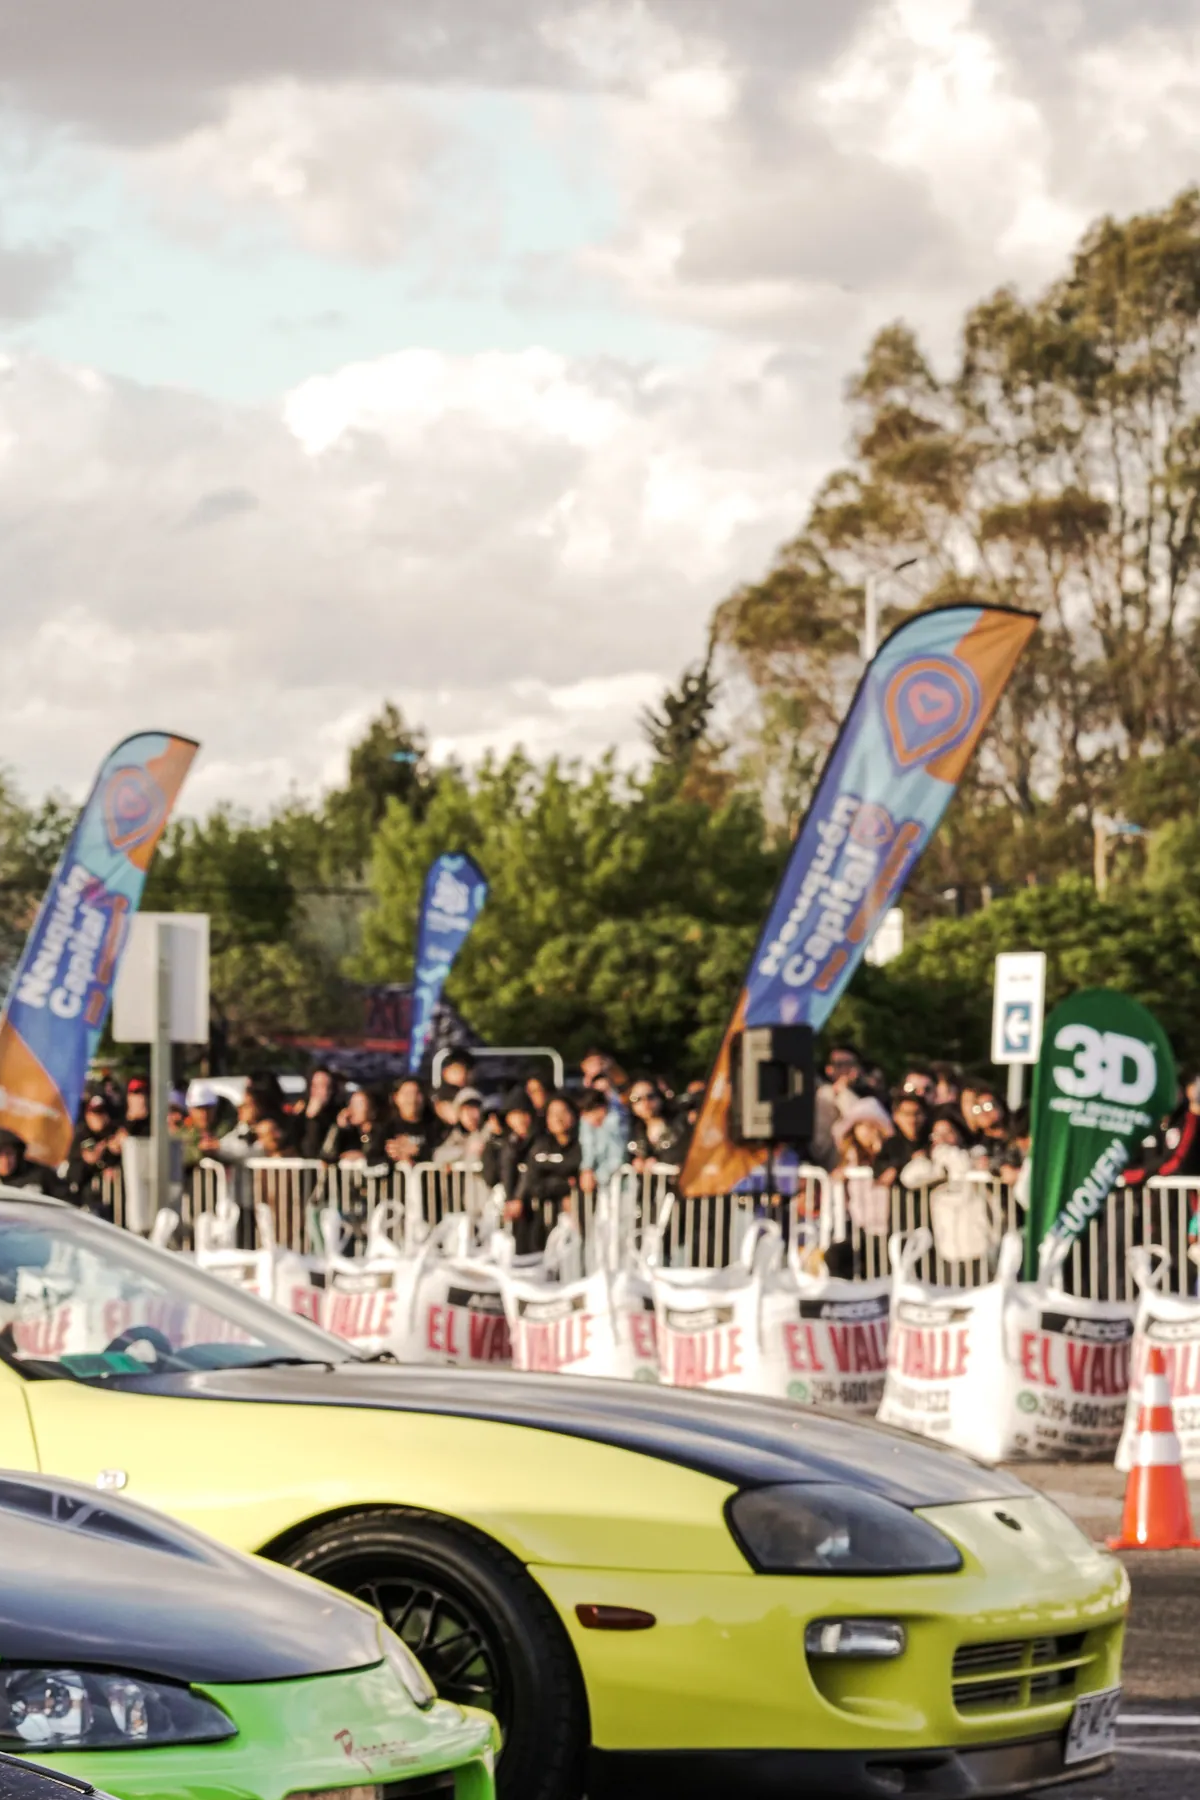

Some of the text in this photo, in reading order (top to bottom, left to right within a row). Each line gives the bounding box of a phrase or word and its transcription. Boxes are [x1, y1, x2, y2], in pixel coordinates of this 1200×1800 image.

[782, 840, 879, 987] Capital
[49, 902, 106, 1020] Capital
[1052, 1023, 1157, 1106] 3D
[429, 1305, 459, 1355] EL
[784, 1321, 824, 1372] EL
[1020, 1332, 1058, 1387] EL
